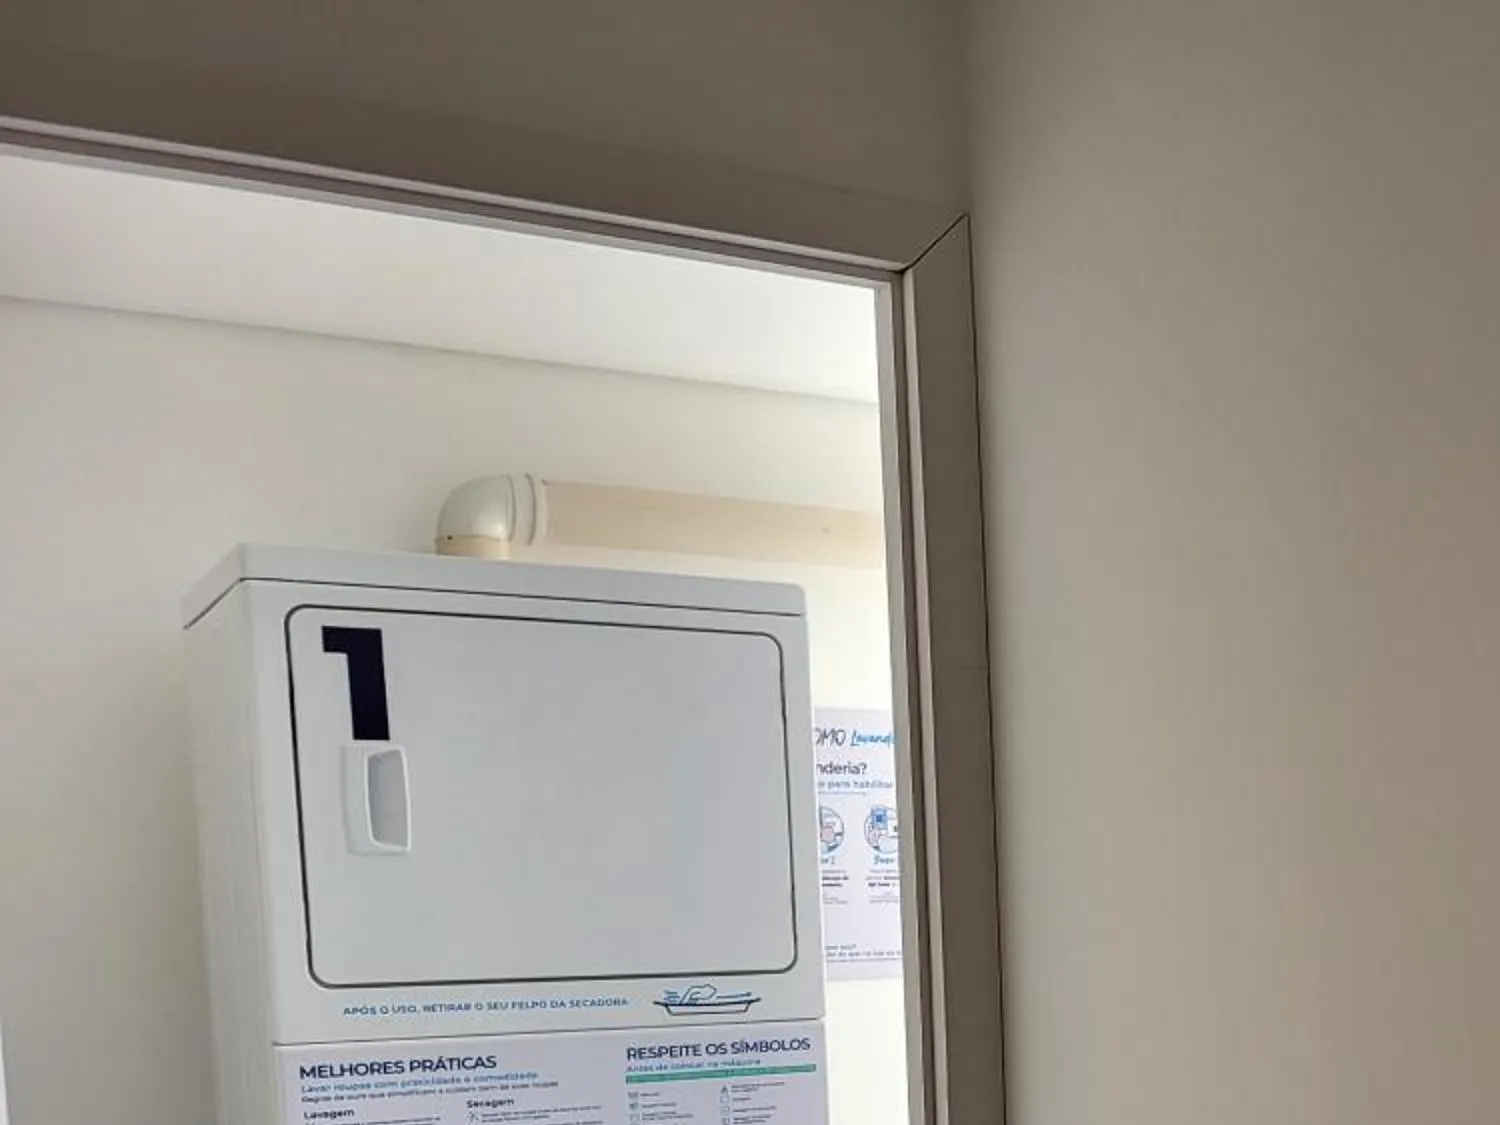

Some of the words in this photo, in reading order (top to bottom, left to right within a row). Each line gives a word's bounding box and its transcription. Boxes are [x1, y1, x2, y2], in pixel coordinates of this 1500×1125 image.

[321, 626, 391, 741] 1
[344, 1004, 376, 1016] APÓS
[380, 1006, 390, 1015] O
[423, 1002, 471, 1014] RETIRAR
[475, 1002, 484, 1012] O
[487, 1001, 509, 1012] SEU
[512, 999, 547, 1010] FELPO
[551, 998, 566, 1009] DA
[569, 997, 629, 1009] SECADORA
[627, 1043, 702, 1061] RESPEITE
[705, 1043, 728, 1056] OS
[730, 1037, 812, 1055] SÍMBOLOS
[300, 1060, 405, 1080] MELHORES
[408, 1055, 498, 1074] PRÁTICAS
[303, 1107, 355, 1120] Lavagem
[465, 1098, 515, 1110] Secagem
